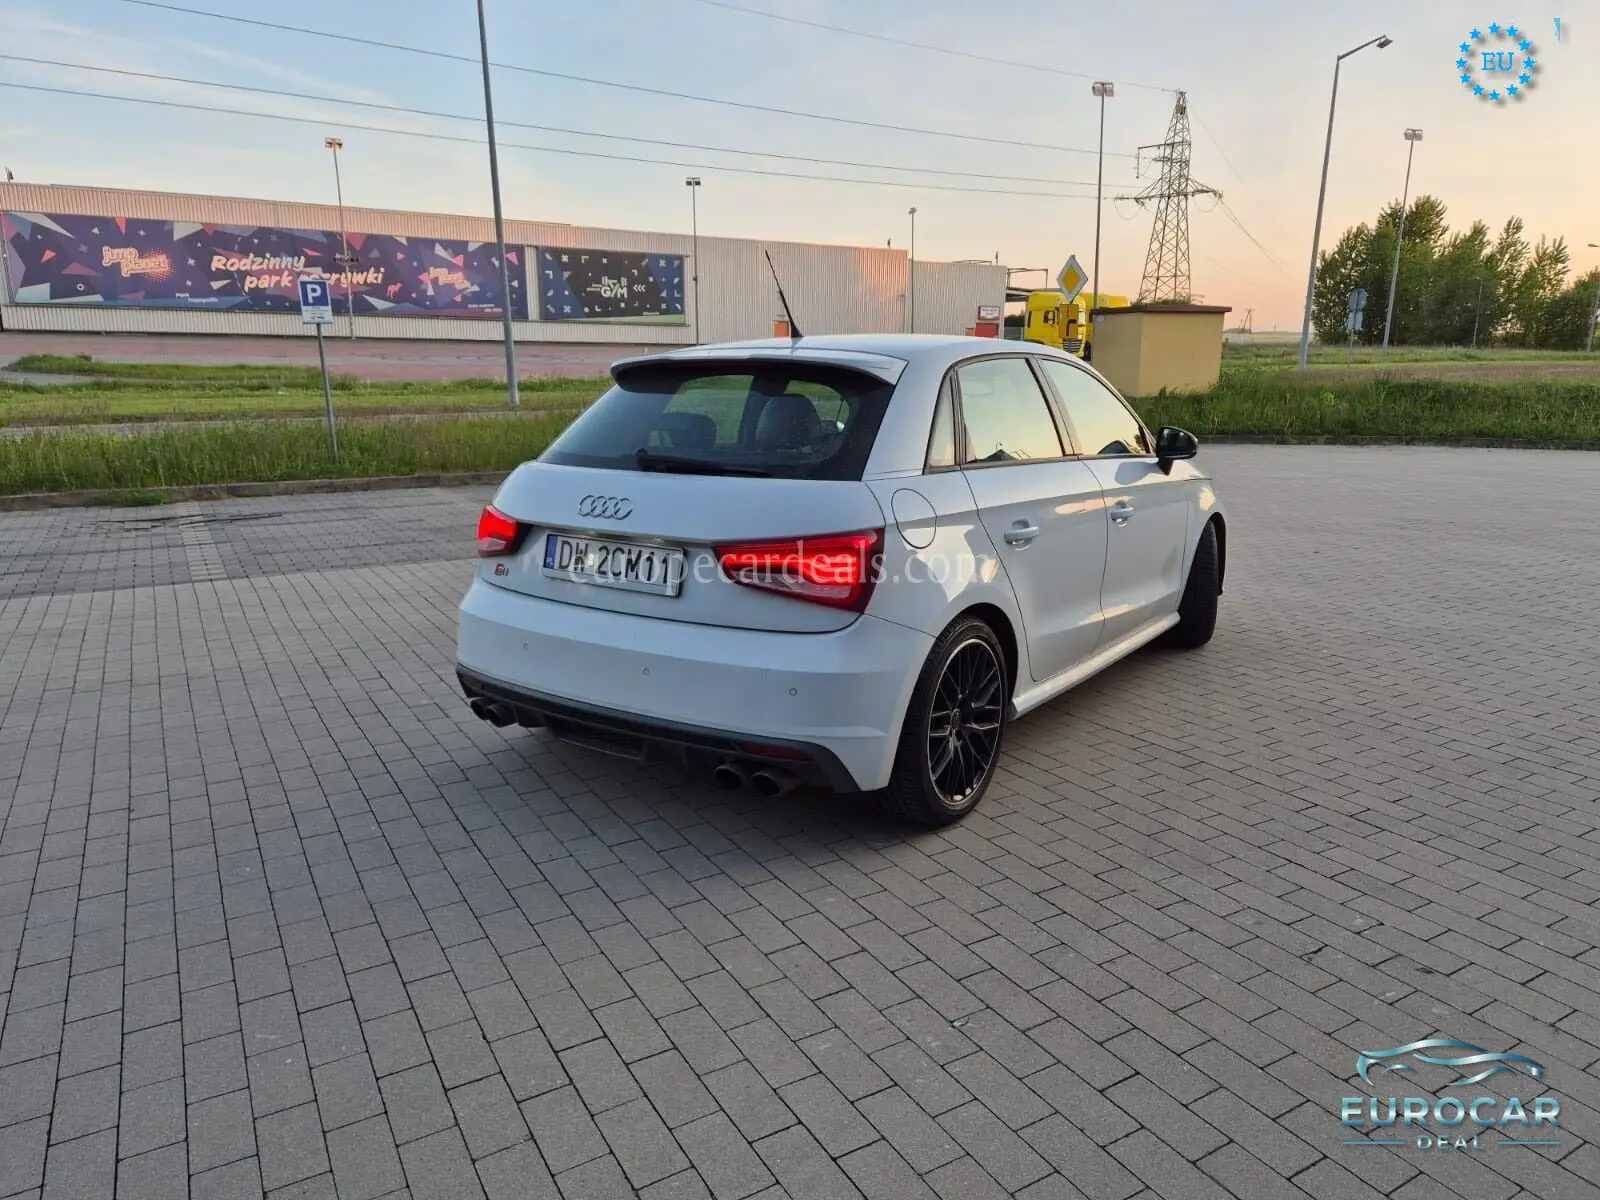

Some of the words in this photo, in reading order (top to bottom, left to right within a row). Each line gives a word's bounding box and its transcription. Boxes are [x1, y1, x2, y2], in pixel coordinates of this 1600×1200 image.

[211, 252, 306, 271] Rodzinny
[244, 270, 293, 292] park
[306, 283, 322, 304] P
[558, 540, 589, 572] DW
